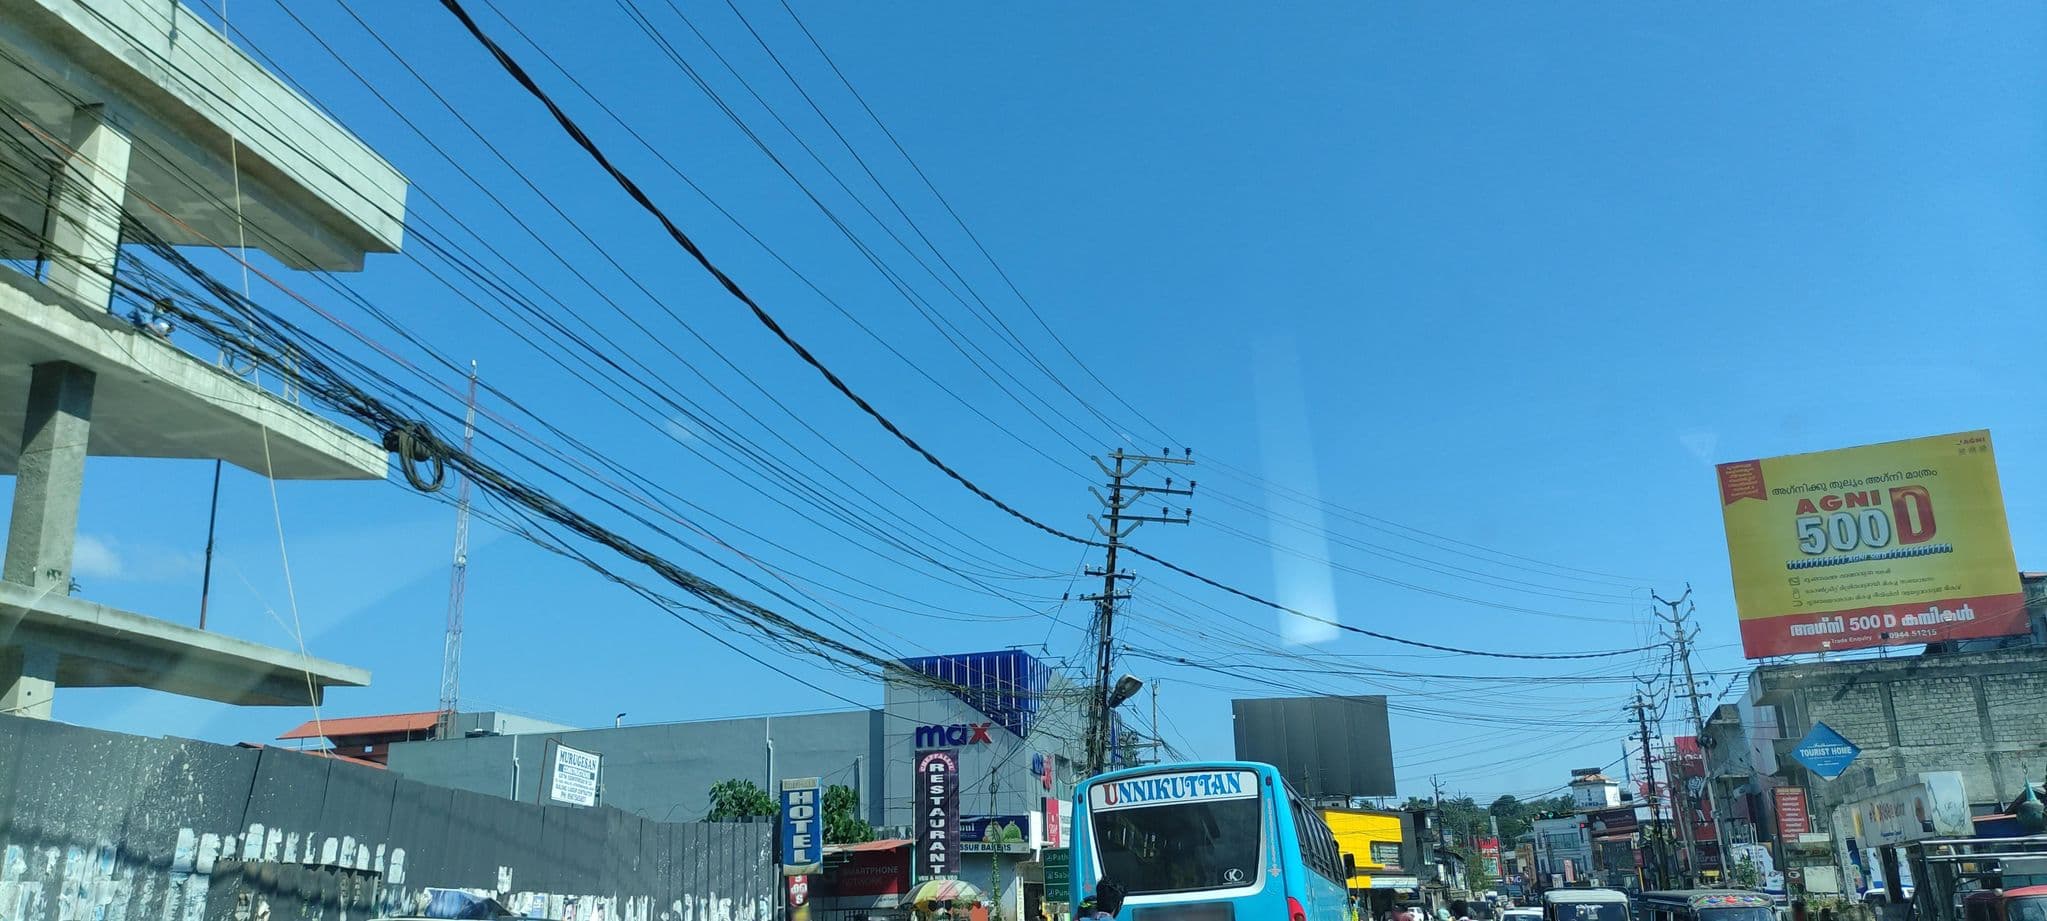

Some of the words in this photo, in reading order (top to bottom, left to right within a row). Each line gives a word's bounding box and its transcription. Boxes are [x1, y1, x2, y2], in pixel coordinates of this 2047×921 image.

[1905, 468, 1938, 480] മാത്രം
[1796, 490, 1882, 515] AGNI
[1796, 508, 1891, 555] 500
[1889, 485, 1937, 545] D
[1850, 614, 1881, 631] 500
[1884, 614, 1896, 629] D
[916, 723, 993, 748] max
[560, 750, 597, 770] MURUGESAN
[1800, 747, 1830, 758] TOURIST
[1831, 746, 1852, 756] HOME
[1103, 772, 1242, 805] UNNIKUTTAN
[789, 791, 814, 863] HOTEL
[929, 763, 945, 874] RESTAURANT
[842, 866, 899, 876] ARTPHONE
